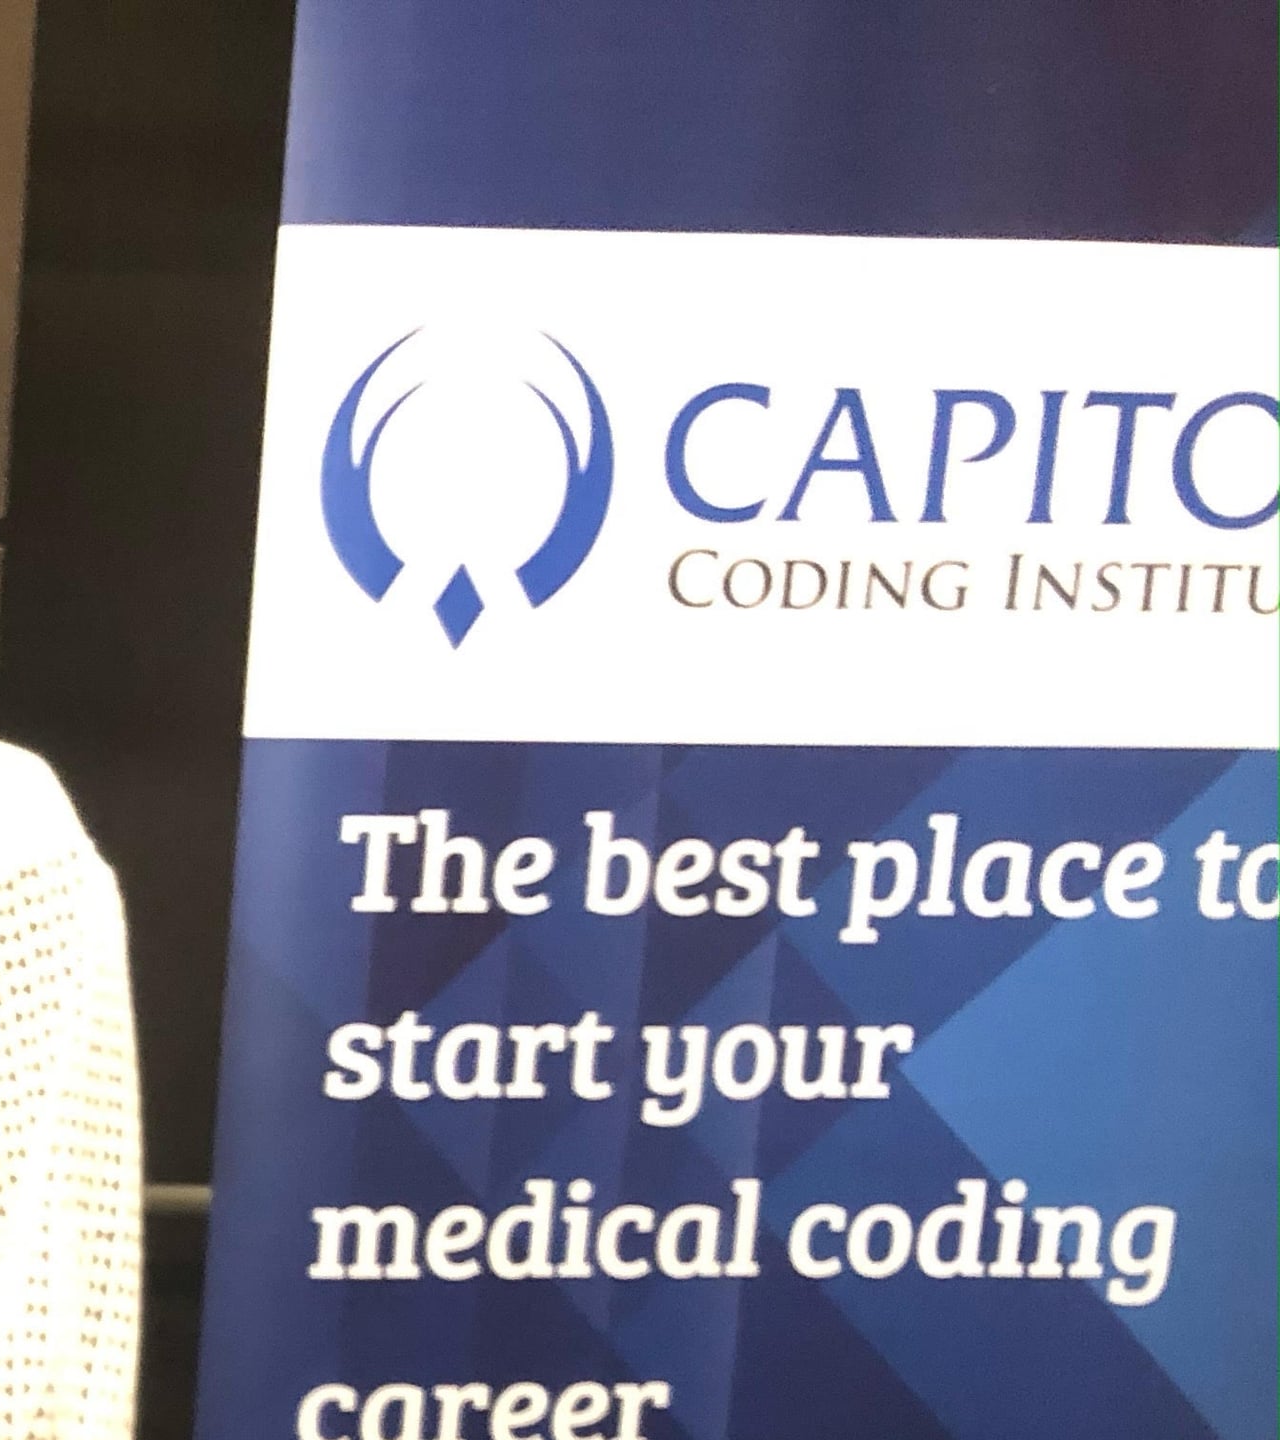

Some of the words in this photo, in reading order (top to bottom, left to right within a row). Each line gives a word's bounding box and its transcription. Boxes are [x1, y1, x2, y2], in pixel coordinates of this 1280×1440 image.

[667, 549, 969, 611] CODING
[339, 808, 555, 916] The
[584, 809, 821, 918] best
[838, 812, 1165, 945] place
[1194, 829, 1280, 921] to
[323, 1009, 616, 1102] start
[640, 1022, 916, 1128] your
[307, 1177, 762, 1282] medical
[788, 1177, 1178, 1307] coding
